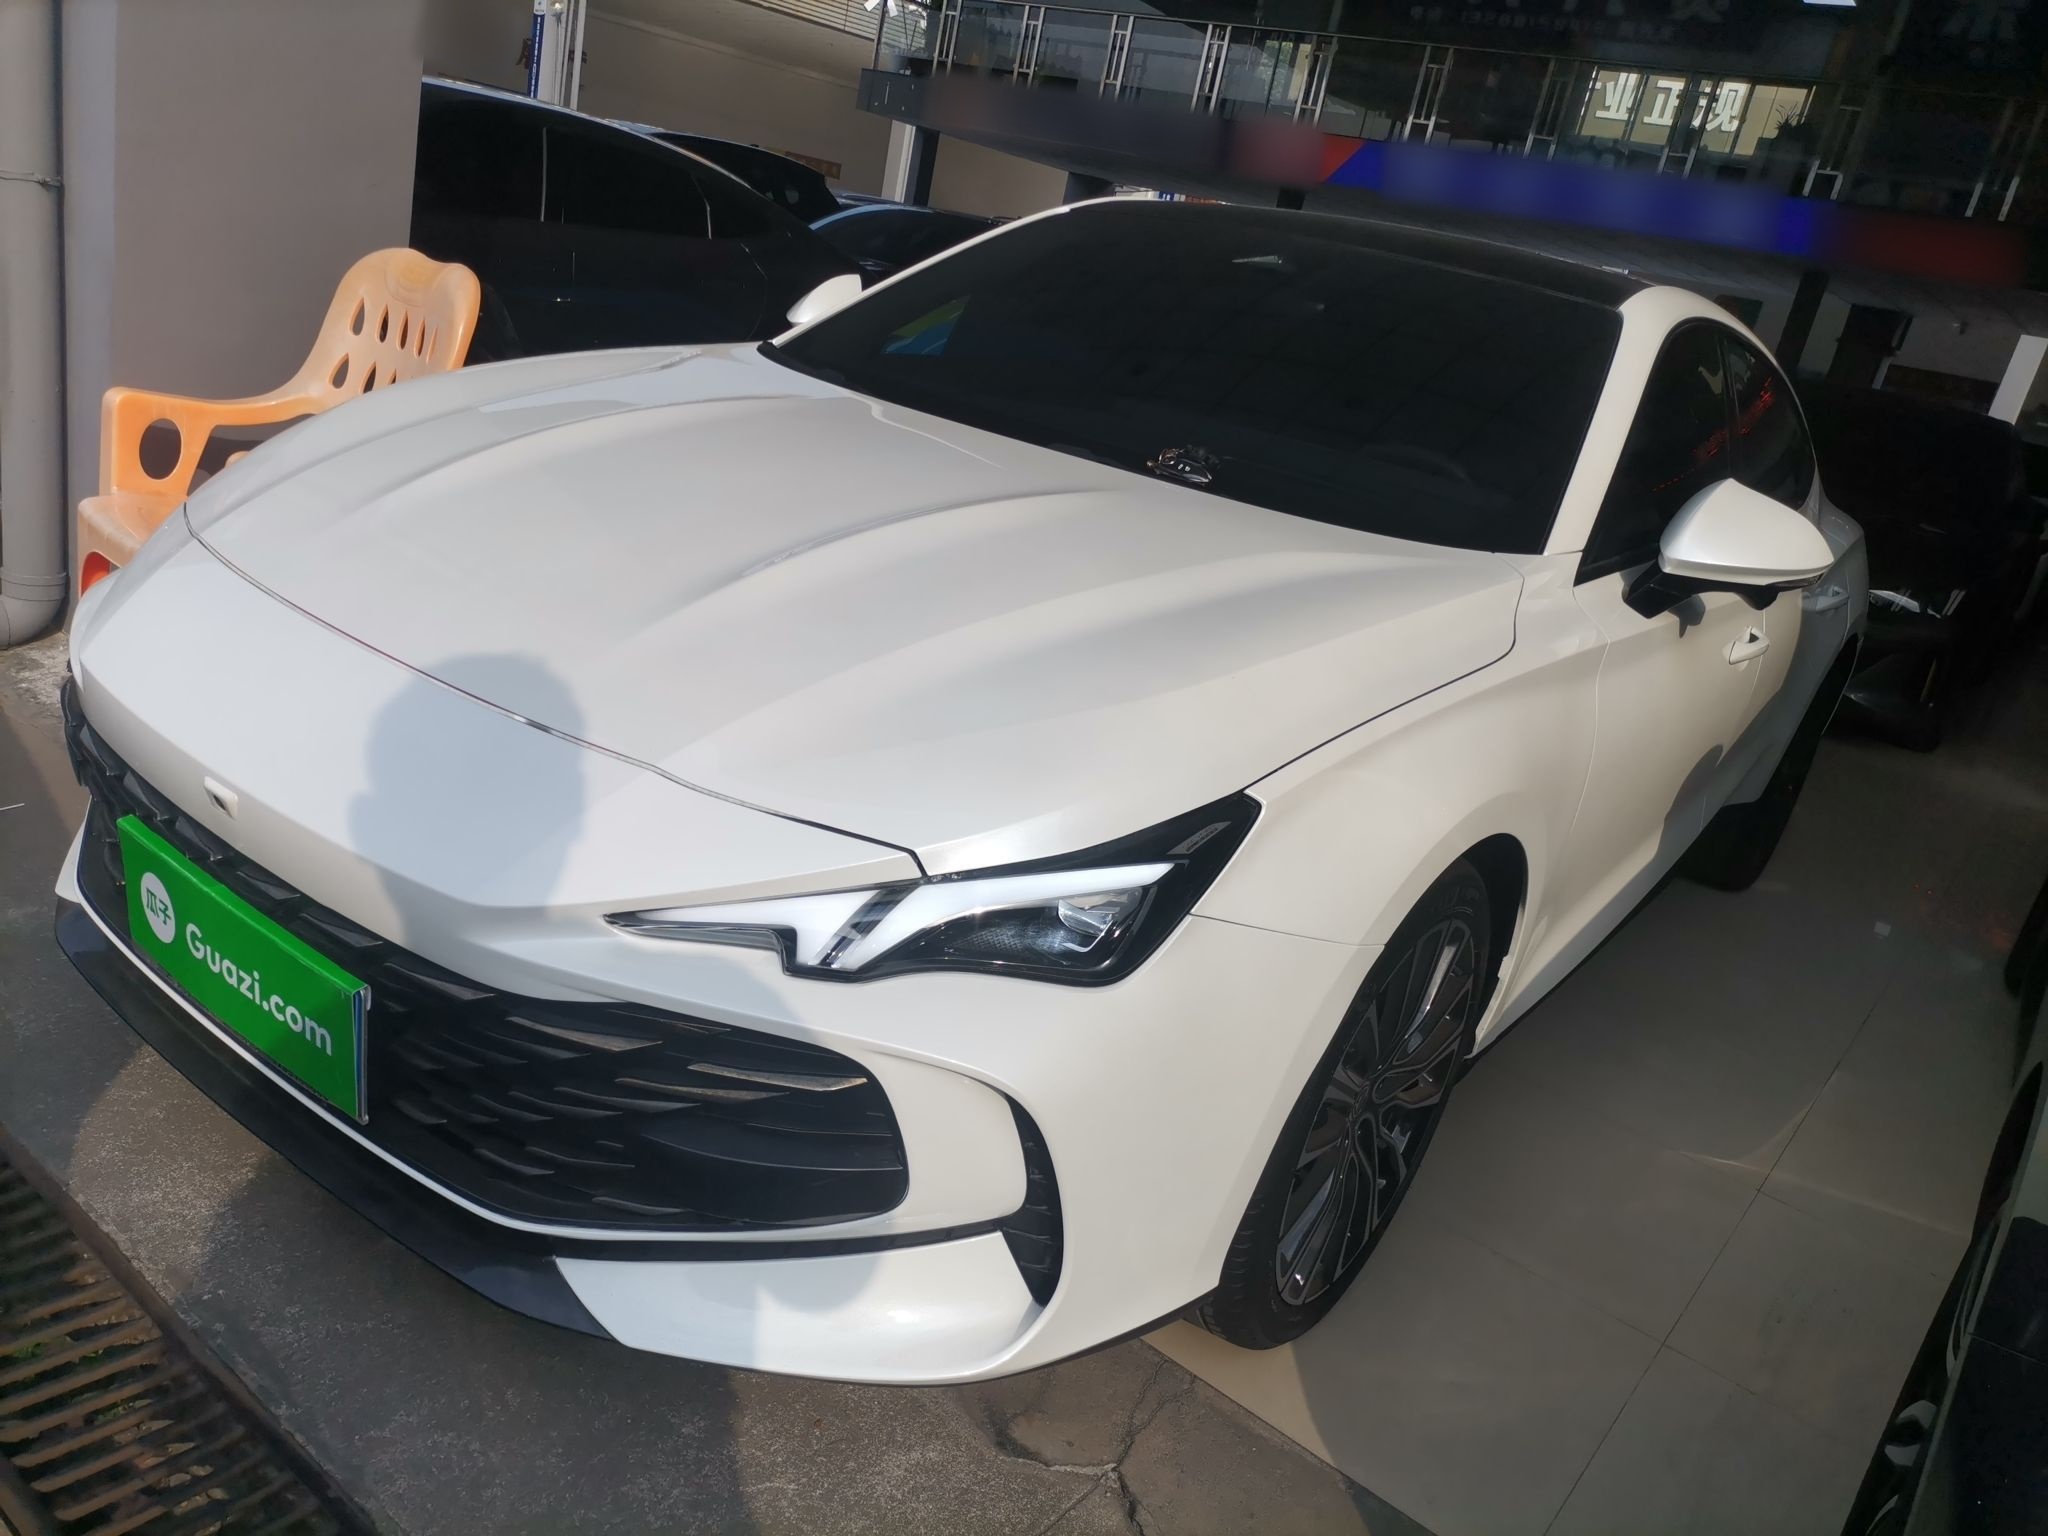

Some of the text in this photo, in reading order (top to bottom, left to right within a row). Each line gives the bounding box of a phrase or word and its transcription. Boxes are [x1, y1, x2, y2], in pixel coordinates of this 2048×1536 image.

[1595, 73, 1751, 132] 业正规
[146, 888, 172, 925] 瓜子
[186, 923, 332, 1056] Guazi.com
